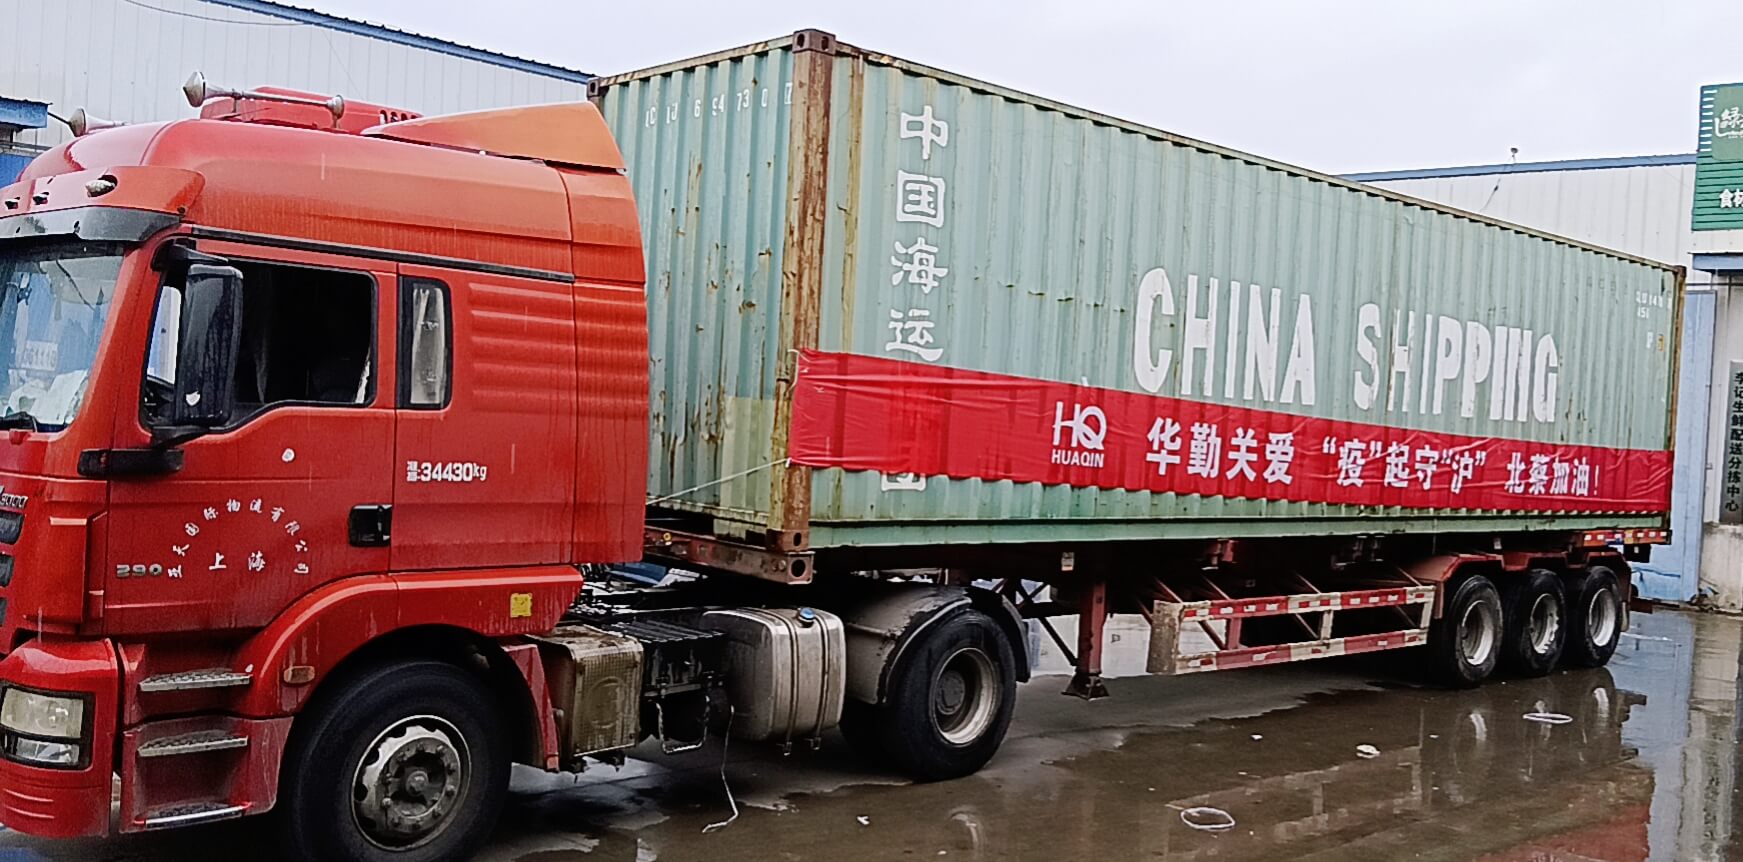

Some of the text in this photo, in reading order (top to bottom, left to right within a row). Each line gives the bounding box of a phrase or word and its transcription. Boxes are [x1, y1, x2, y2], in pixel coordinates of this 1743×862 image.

[881, 105, 948, 492] 中国海运
[1134, 267, 1558, 423] CHINA SHIPPING
[1052, 401, 1107, 450] HQ
[1051, 450, 1104, 468] HUAQIN
[1146, 416, 1294, 485] 华勤关爱
[116, 564, 163, 578] 290
[208, 551, 266, 573] 上海
